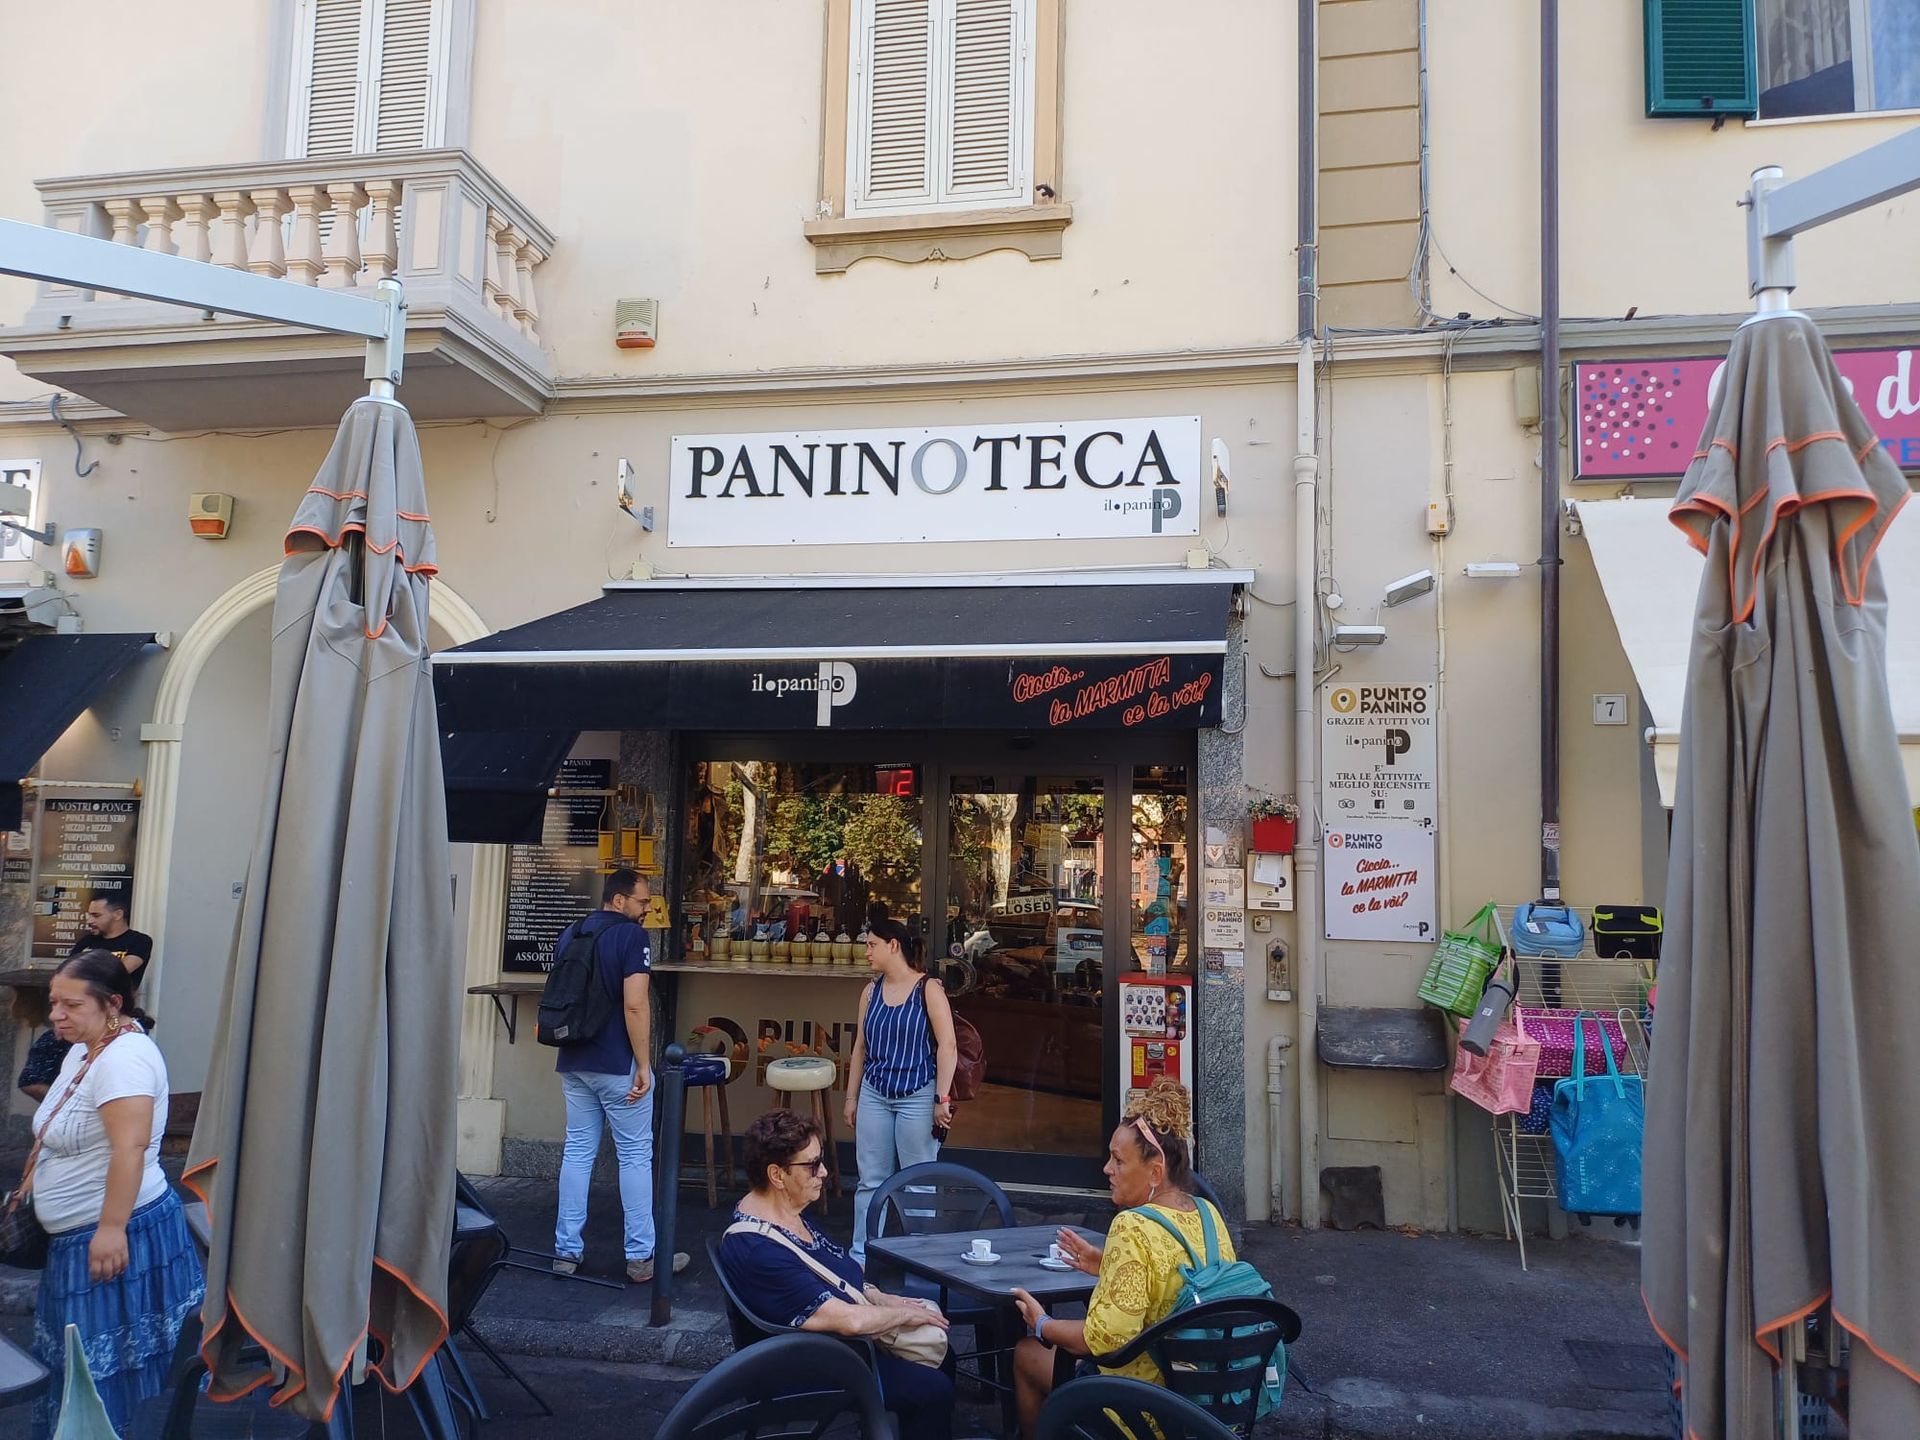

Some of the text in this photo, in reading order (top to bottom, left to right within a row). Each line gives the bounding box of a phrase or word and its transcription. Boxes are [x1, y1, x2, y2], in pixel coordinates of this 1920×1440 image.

[685, 430, 1180, 499] PANINOTECA
[1050, 656, 1170, 726] la MARMITTA
[1360, 687, 1427, 701] PUNTO
[1123, 704, 1144, 726] ce
[1148, 691, 1169, 718] la
[1360, 701, 1427, 714] PANINO
[1605, 701, 1616, 717] 7
[1326, 718, 1430, 726] GRAZIE A TUTTI VOI
[1336, 773, 1356, 781] TRA
[1360, 773, 1372, 781] LE
[1329, 781, 1431, 790] MEGLIO RECENSITE
[1370, 790, 1388, 798] SU:
[58, 802, 92, 812] NOSTRI
[101, 803, 134, 812] PONCE
[1345, 834, 1383, 842] PUNTO
[1345, 841, 1383, 850] PANINO
[1341, 870, 1418, 896] la MARMITTA
[996, 901, 1052, 916] CLOSED
[1352, 903, 1365, 914] ce
[1368, 897, 1382, 911] la
[515, 952, 554, 961] ASSORTI
[757, 1019, 858, 1056] PUNT
